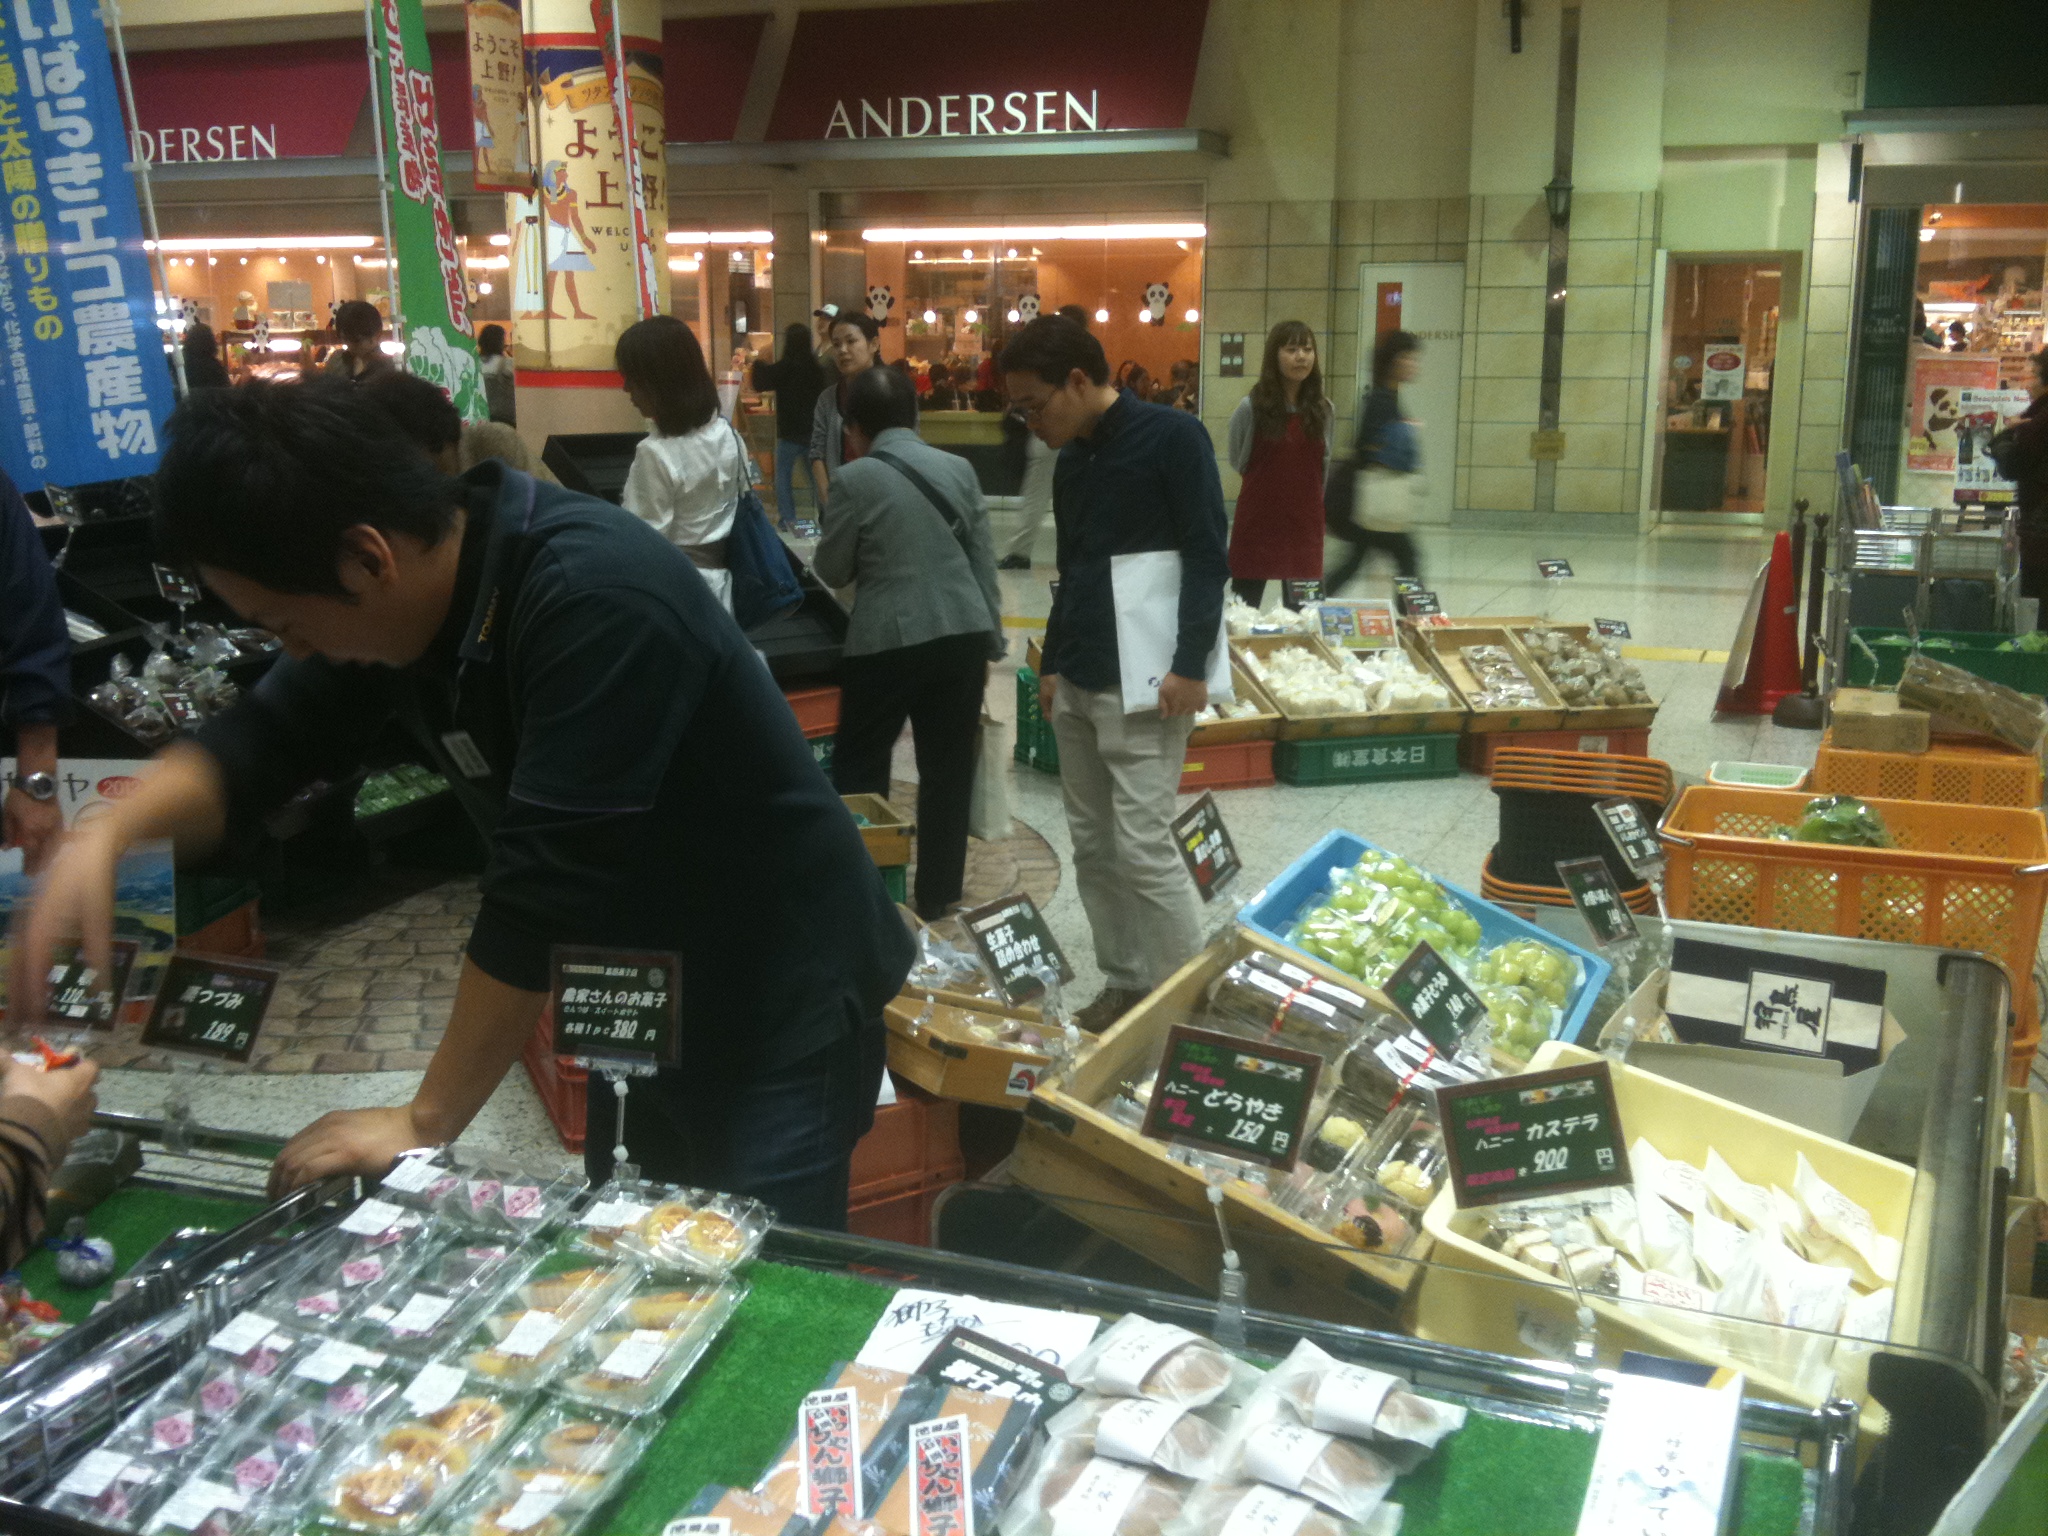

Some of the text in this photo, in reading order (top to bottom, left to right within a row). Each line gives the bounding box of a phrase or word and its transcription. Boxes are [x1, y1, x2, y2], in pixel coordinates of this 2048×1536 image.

[473, 32, 521, 58] ようこそ
[824, 89, 1098, 140] ANDERSEN
[13, 0, 158, 460] いばらきエコ農産物
[561, 987, 668, 1009] 農家さんのお菓子
[1203, 1088, 1285, 1122] どらやき
[1227, 1118, 1291, 1149] 150 円
[1525, 1112, 1600, 1142] カステラ
[1534, 1146, 1615, 1173] 900 円
